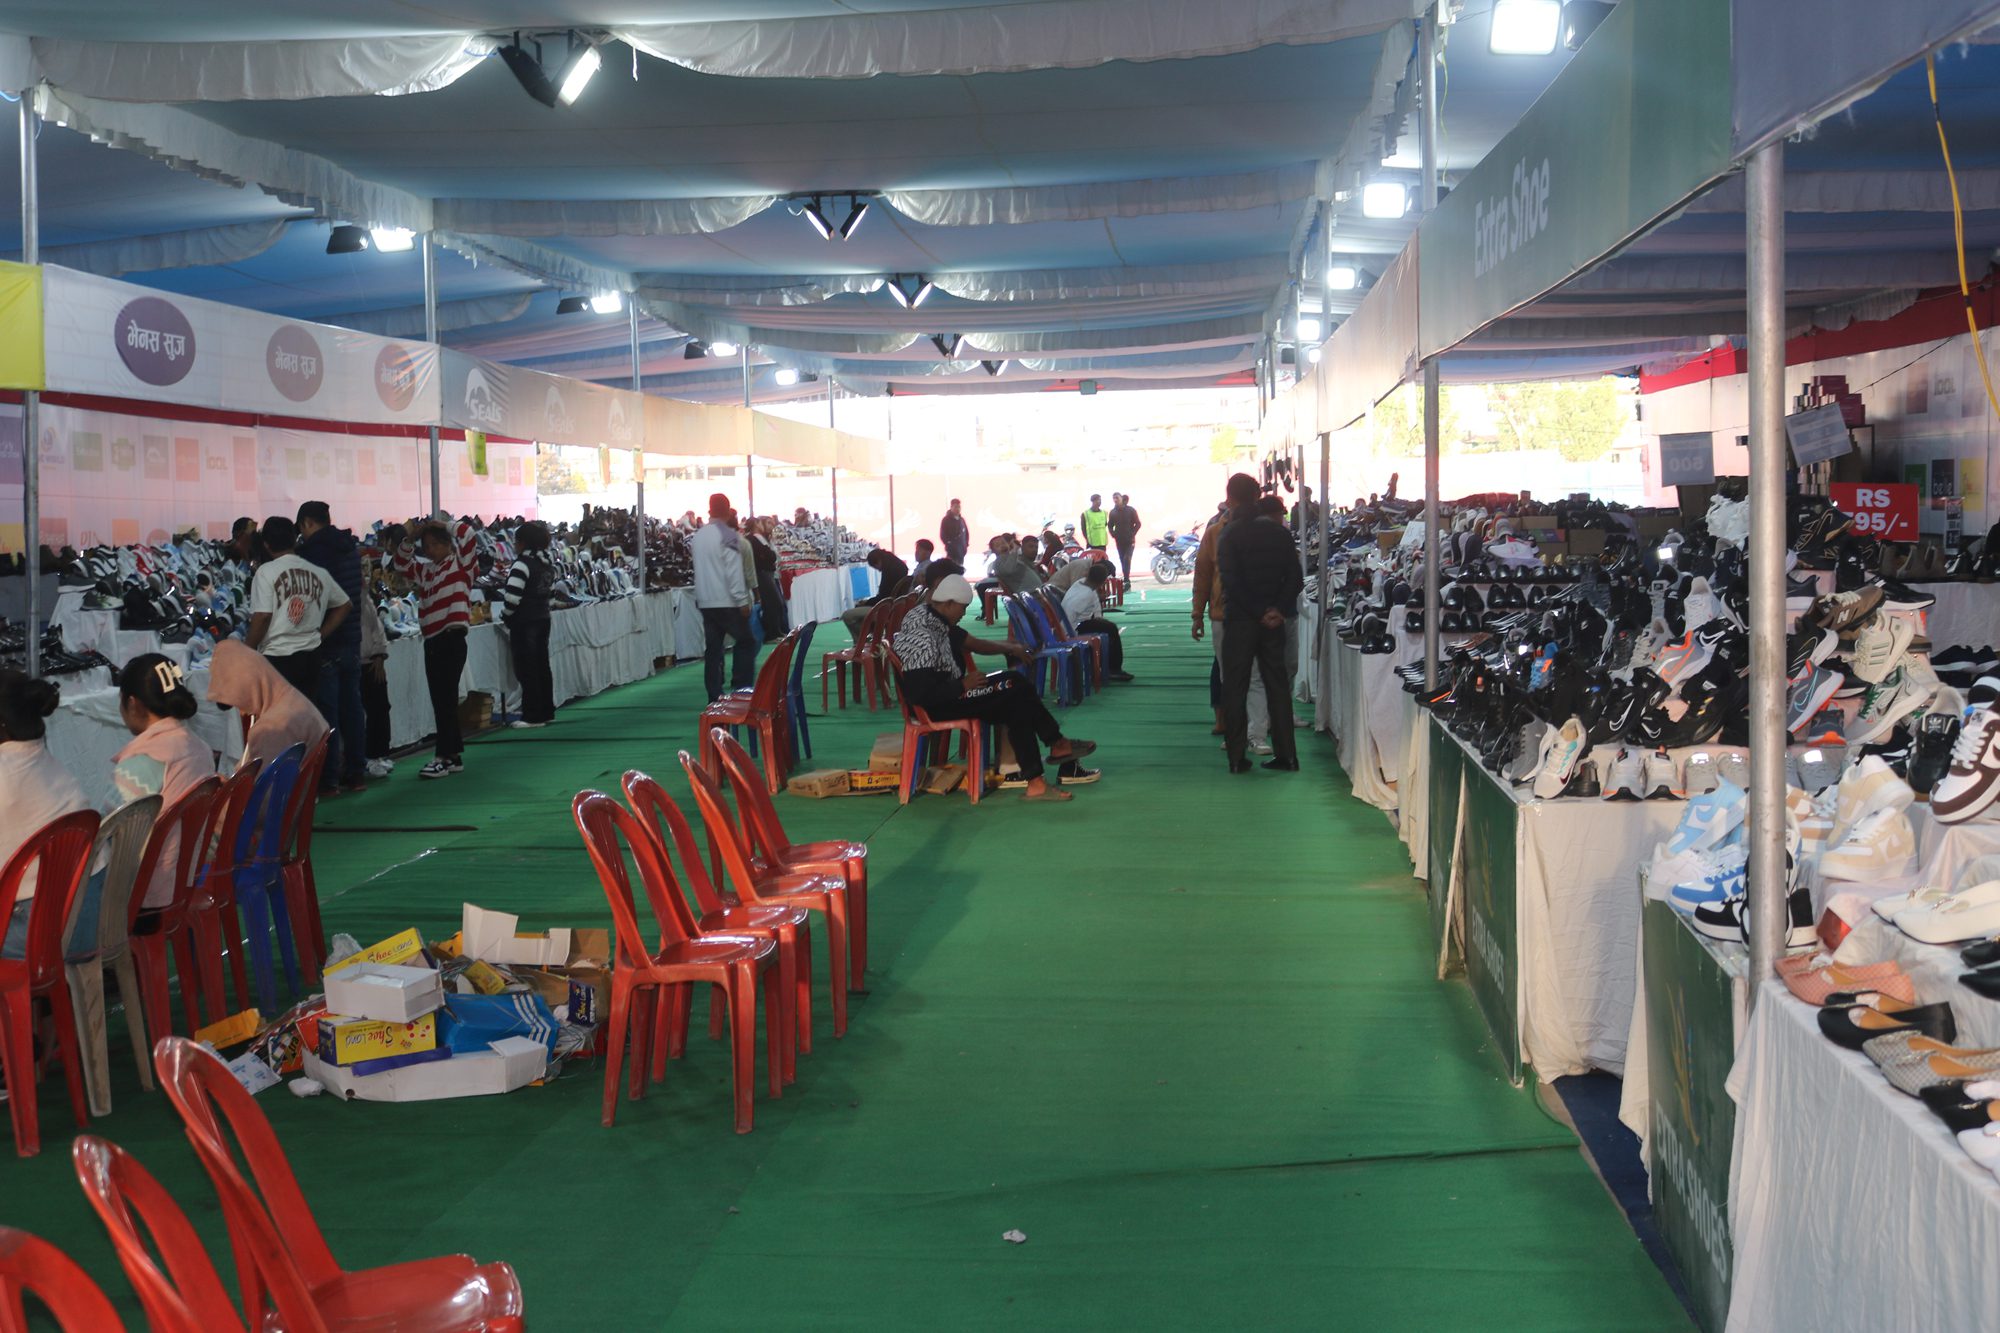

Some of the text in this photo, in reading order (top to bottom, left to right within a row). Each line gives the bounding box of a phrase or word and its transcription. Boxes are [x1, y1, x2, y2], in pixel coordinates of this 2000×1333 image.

[1475, 156, 1550, 279] Extra Shoe
[1856, 488, 1891, 508] RS
[1472, 904, 1504, 996] EXTRA SHOES
[367, 1026, 394, 1048] Shoe
[1655, 1100, 1728, 1284] EXTRA SHOES
